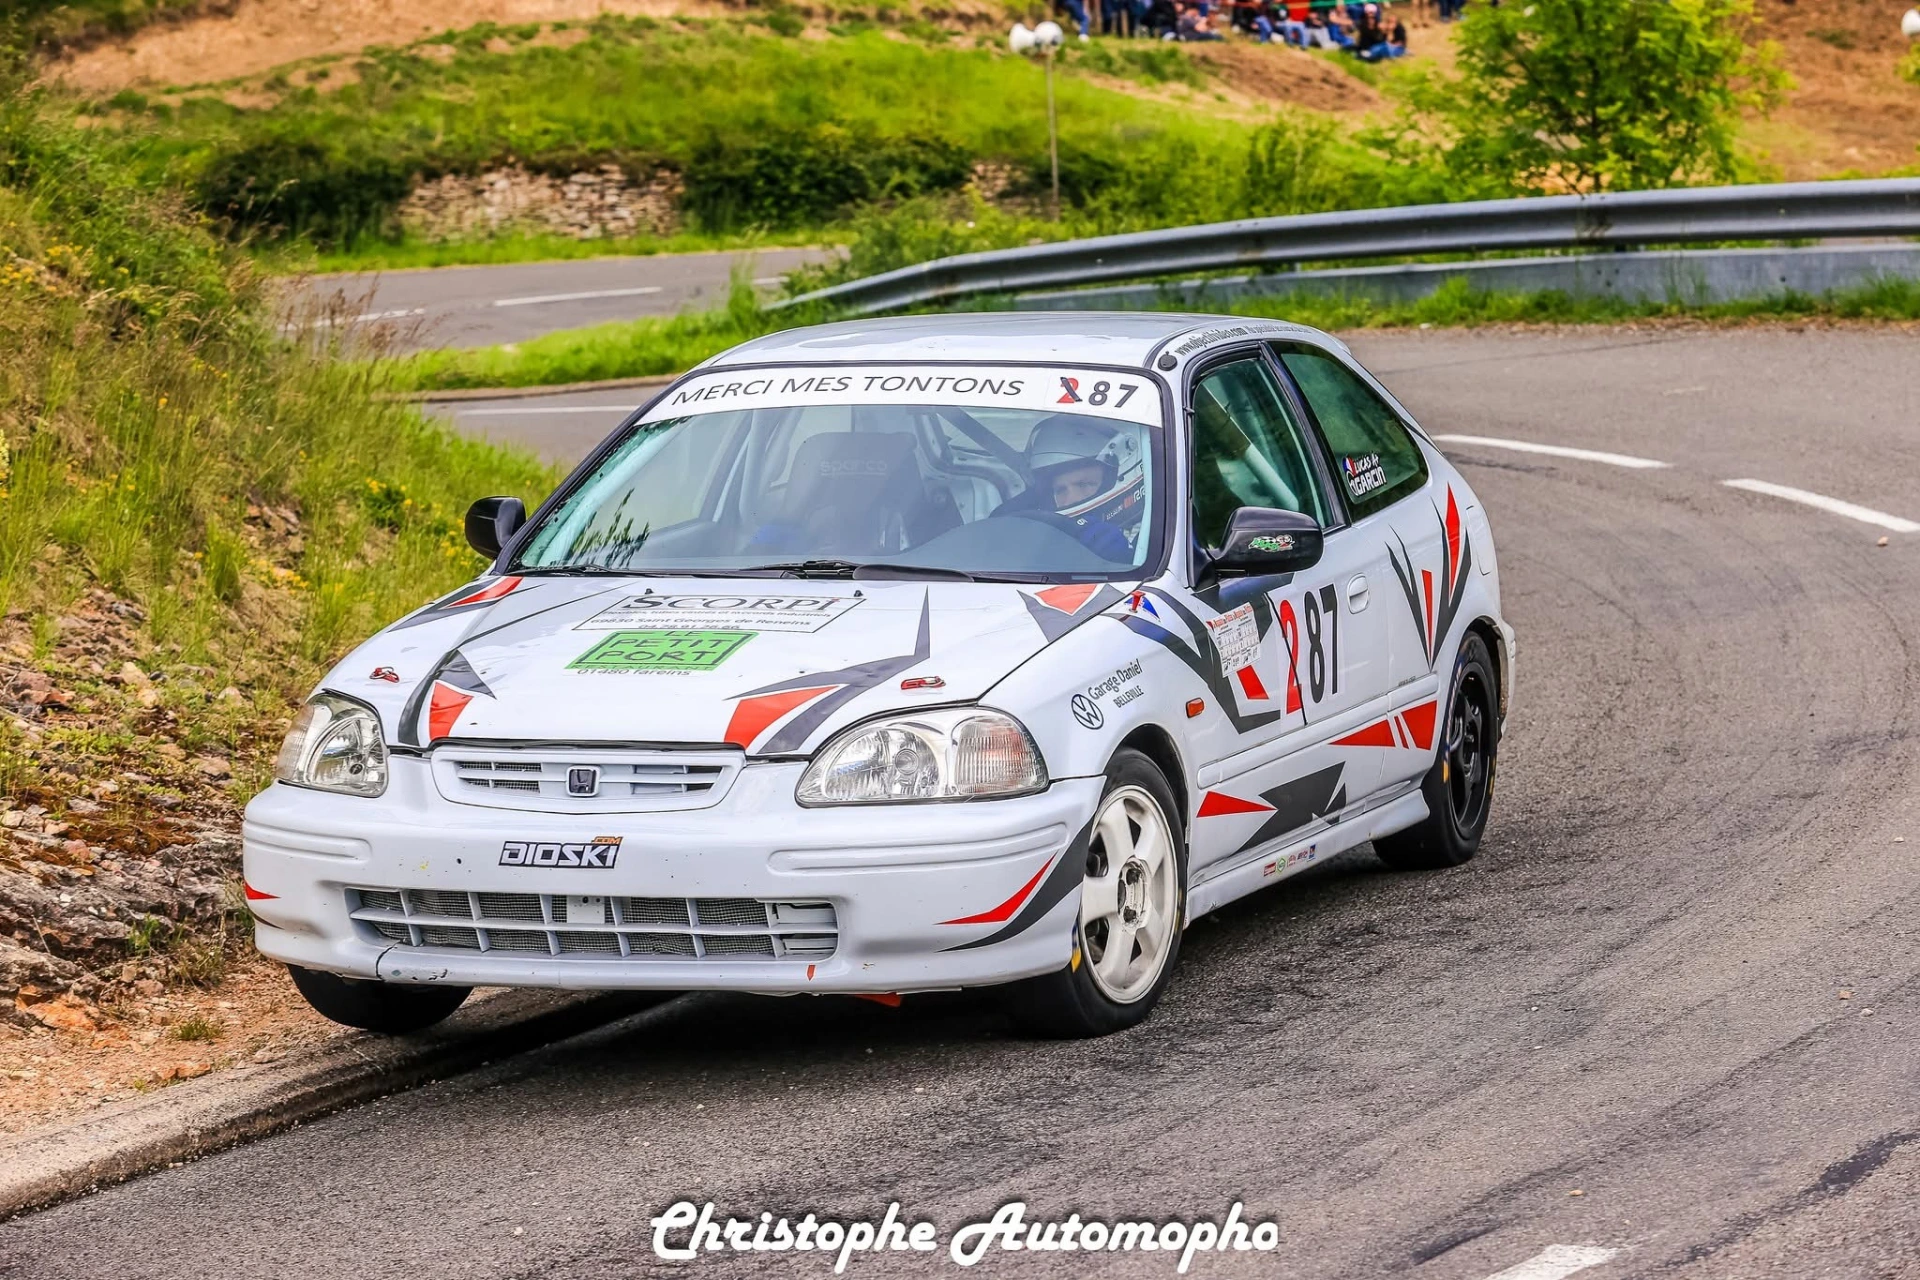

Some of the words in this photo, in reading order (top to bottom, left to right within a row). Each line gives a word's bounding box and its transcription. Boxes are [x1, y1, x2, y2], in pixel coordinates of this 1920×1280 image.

[671, 379, 774, 406] MERCI
[780, 376, 853, 394] MES
[863, 376, 1025, 396] TONTONS
[1088, 380, 1139, 408] 87
[1353, 456, 1371, 474] LUCAS
[608, 638, 734, 649] PETIT
[1303, 583, 1338, 704] 87
[594, 650, 718, 662] PORT
[1087, 674, 1121, 700] Garage
[1115, 658, 1143, 683] Daniel
[1112, 685, 1145, 708] BELLEVILLE
[499, 842, 619, 868] DIOSKI
